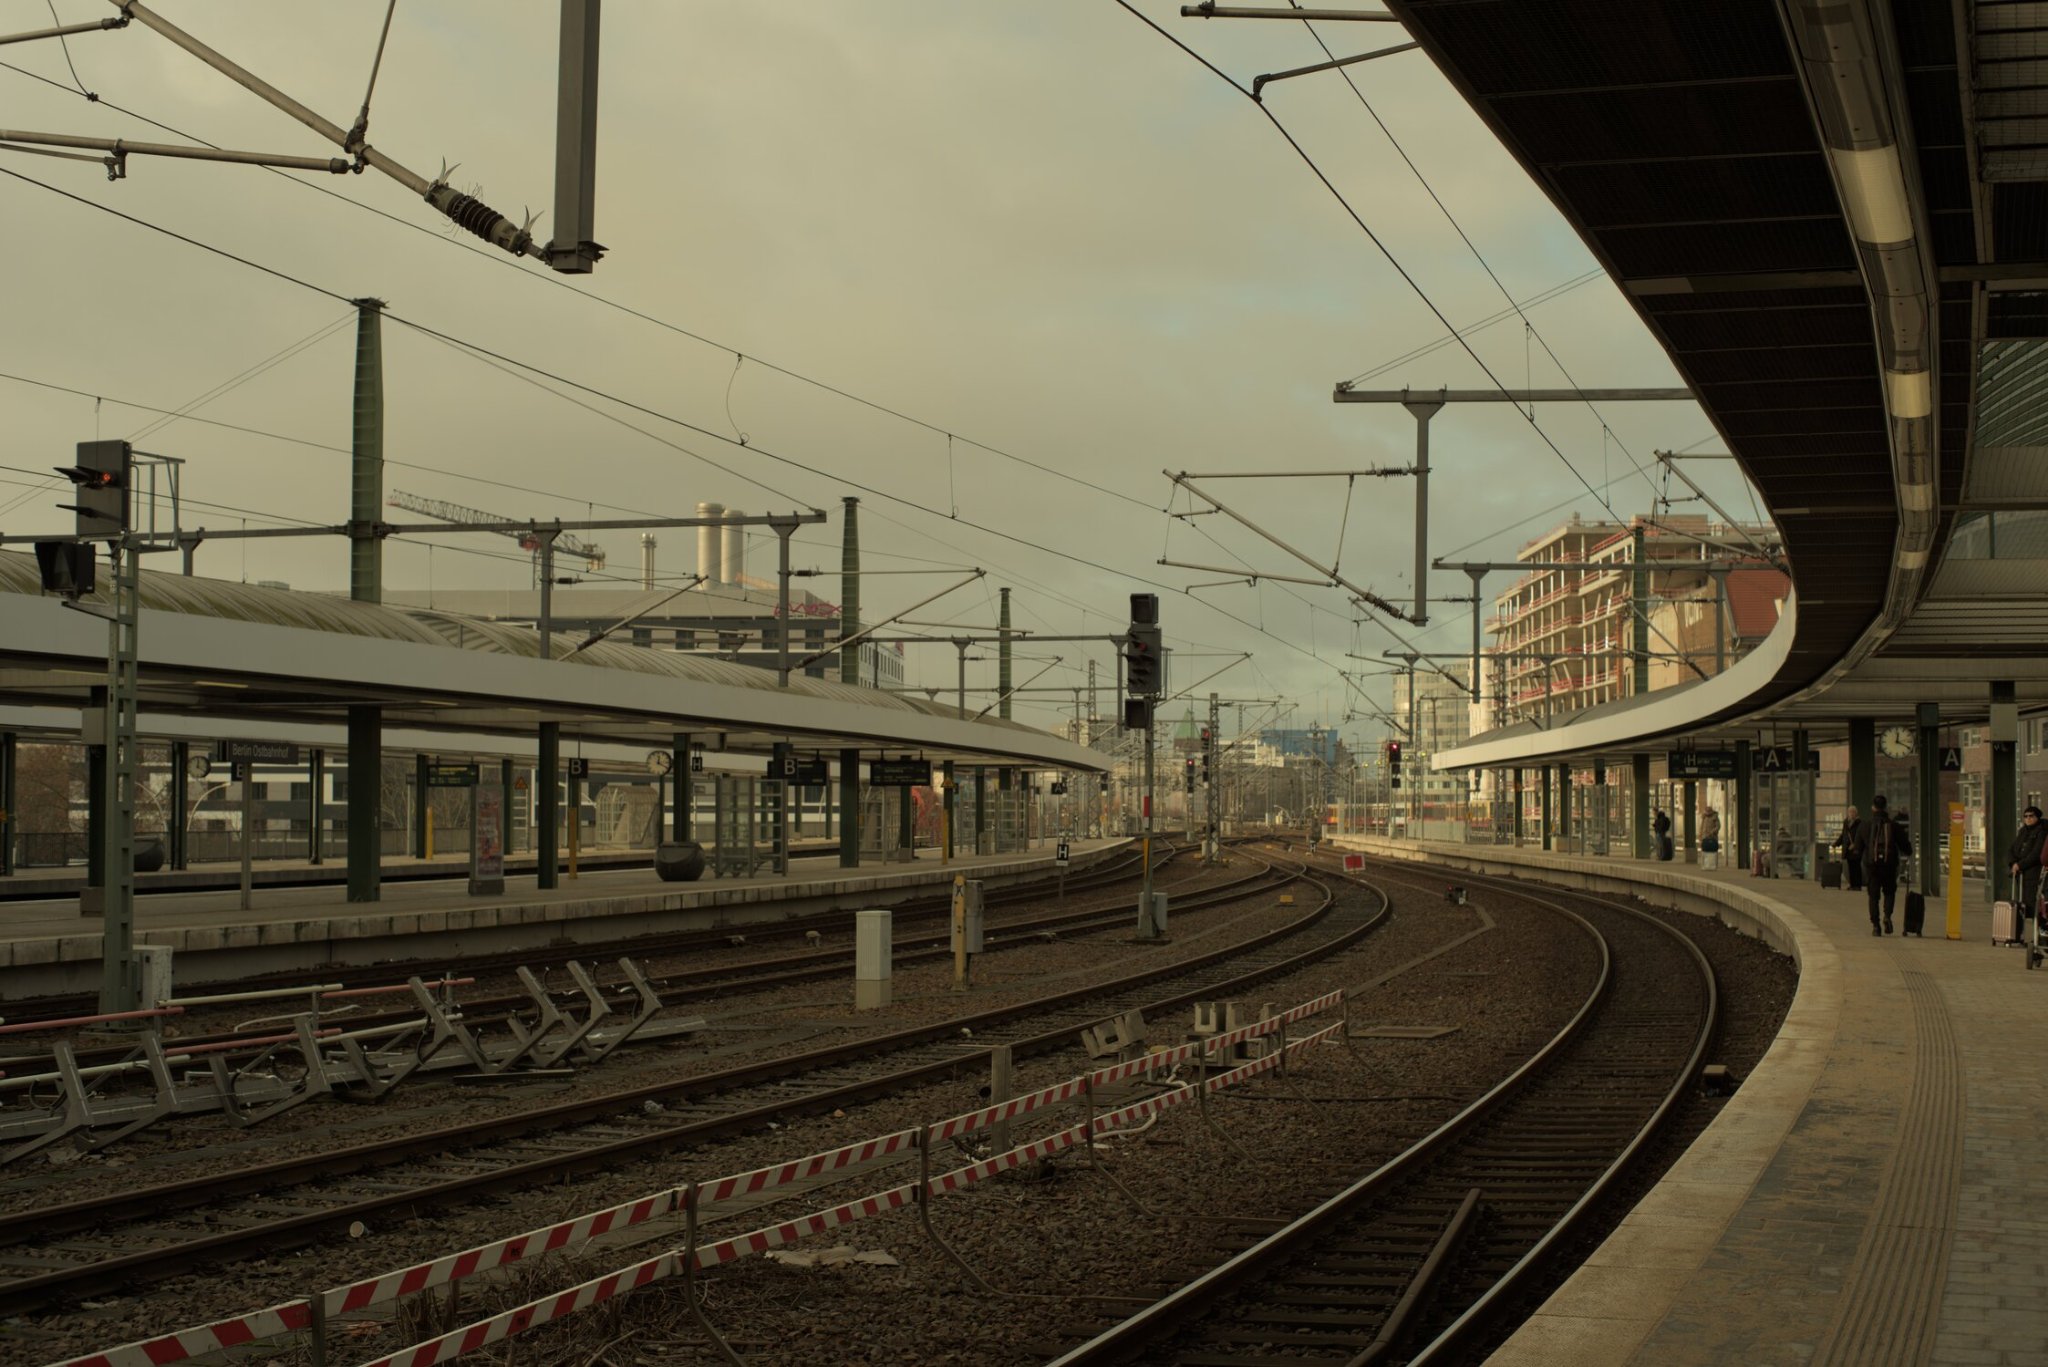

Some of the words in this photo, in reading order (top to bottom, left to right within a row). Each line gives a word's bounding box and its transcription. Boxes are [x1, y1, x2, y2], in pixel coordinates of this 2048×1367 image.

[232, 743, 252, 757] Berlin
[1944, 748, 1960, 767] A
[693, 758, 701, 771] H
[1687, 753, 1697, 766] H
[1765, 750, 1780, 768] A
[570, 759, 582, 775] B
[784, 759, 796, 775] B
[1058, 845, 1068, 859] H
